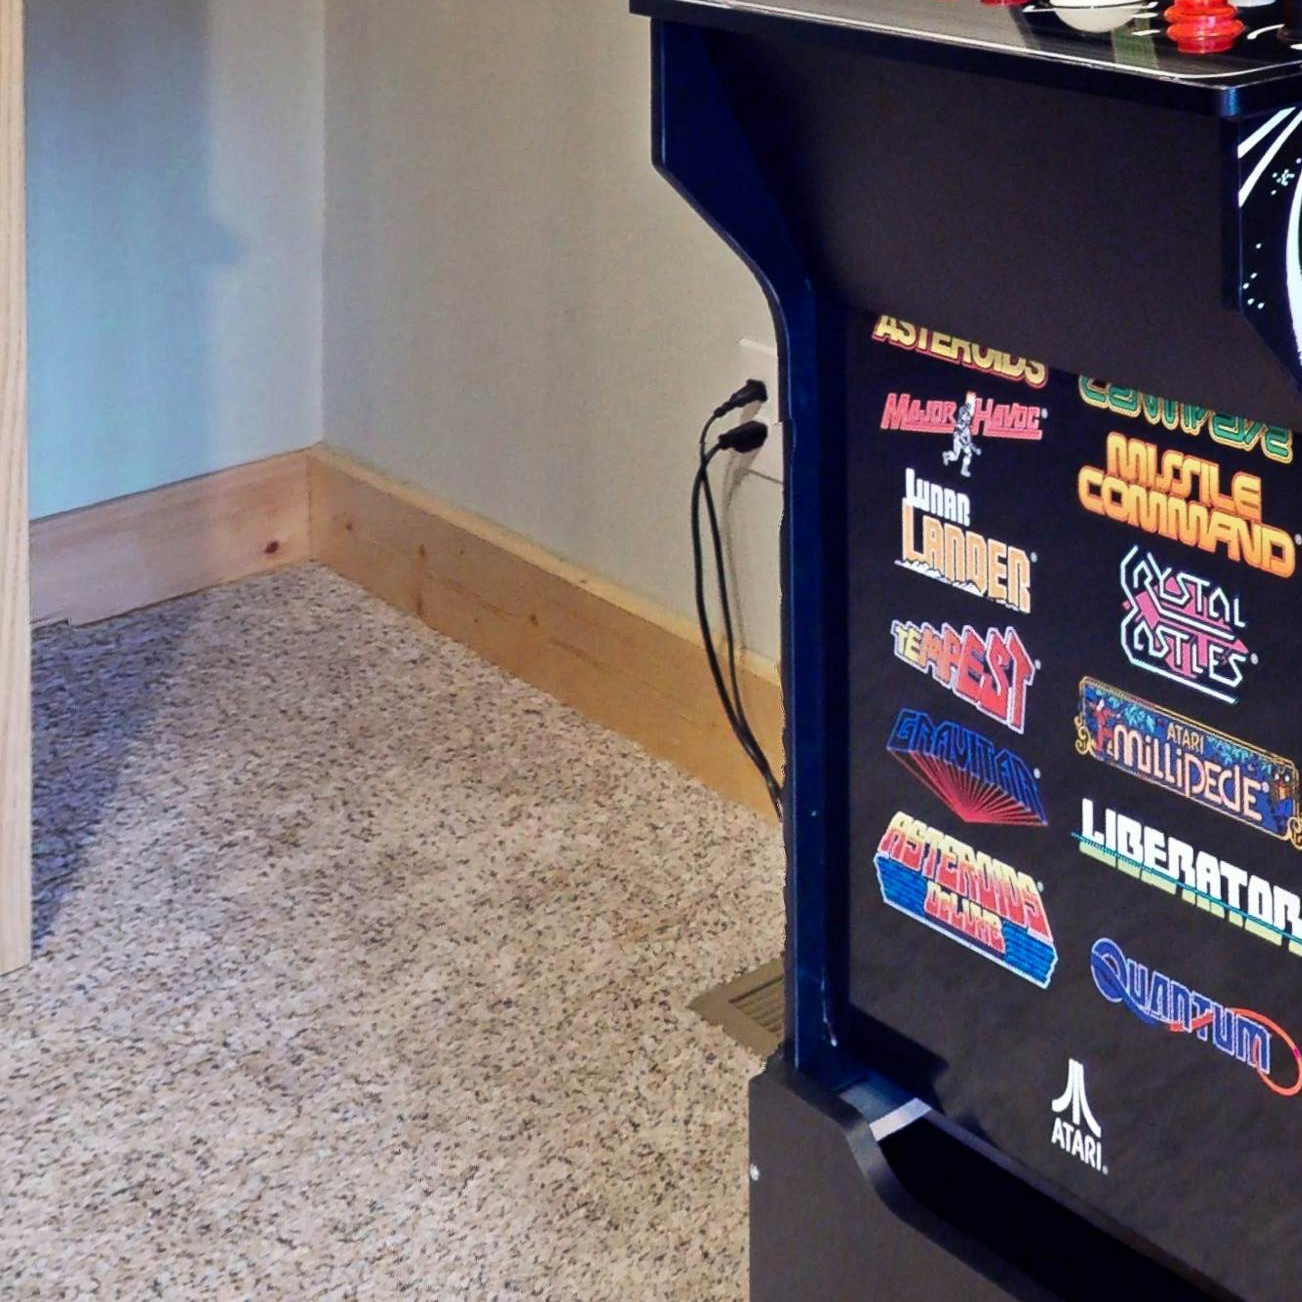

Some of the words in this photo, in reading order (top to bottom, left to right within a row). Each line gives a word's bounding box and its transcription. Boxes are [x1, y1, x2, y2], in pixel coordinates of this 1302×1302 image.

[880, 392, 957, 433] MAJOR
[971, 396, 1044, 440] HAVOC
[903, 467, 970, 527] LUNAR
[1079, 466, 1296, 578] COMMAND
[1107, 432, 1261, 523] MISSILE
[902, 502, 1031, 613] LANDER
[891, 620, 1035, 734] TEMPEST
[886, 708, 1049, 825] GRAVITAR
[1167, 723, 1204, 754] ATARI
[877, 810, 1054, 944] ASTEROIDS
[1090, 937, 1272, 1074] QUANTUM
[1051, 1116, 1103, 1171] ATARI
